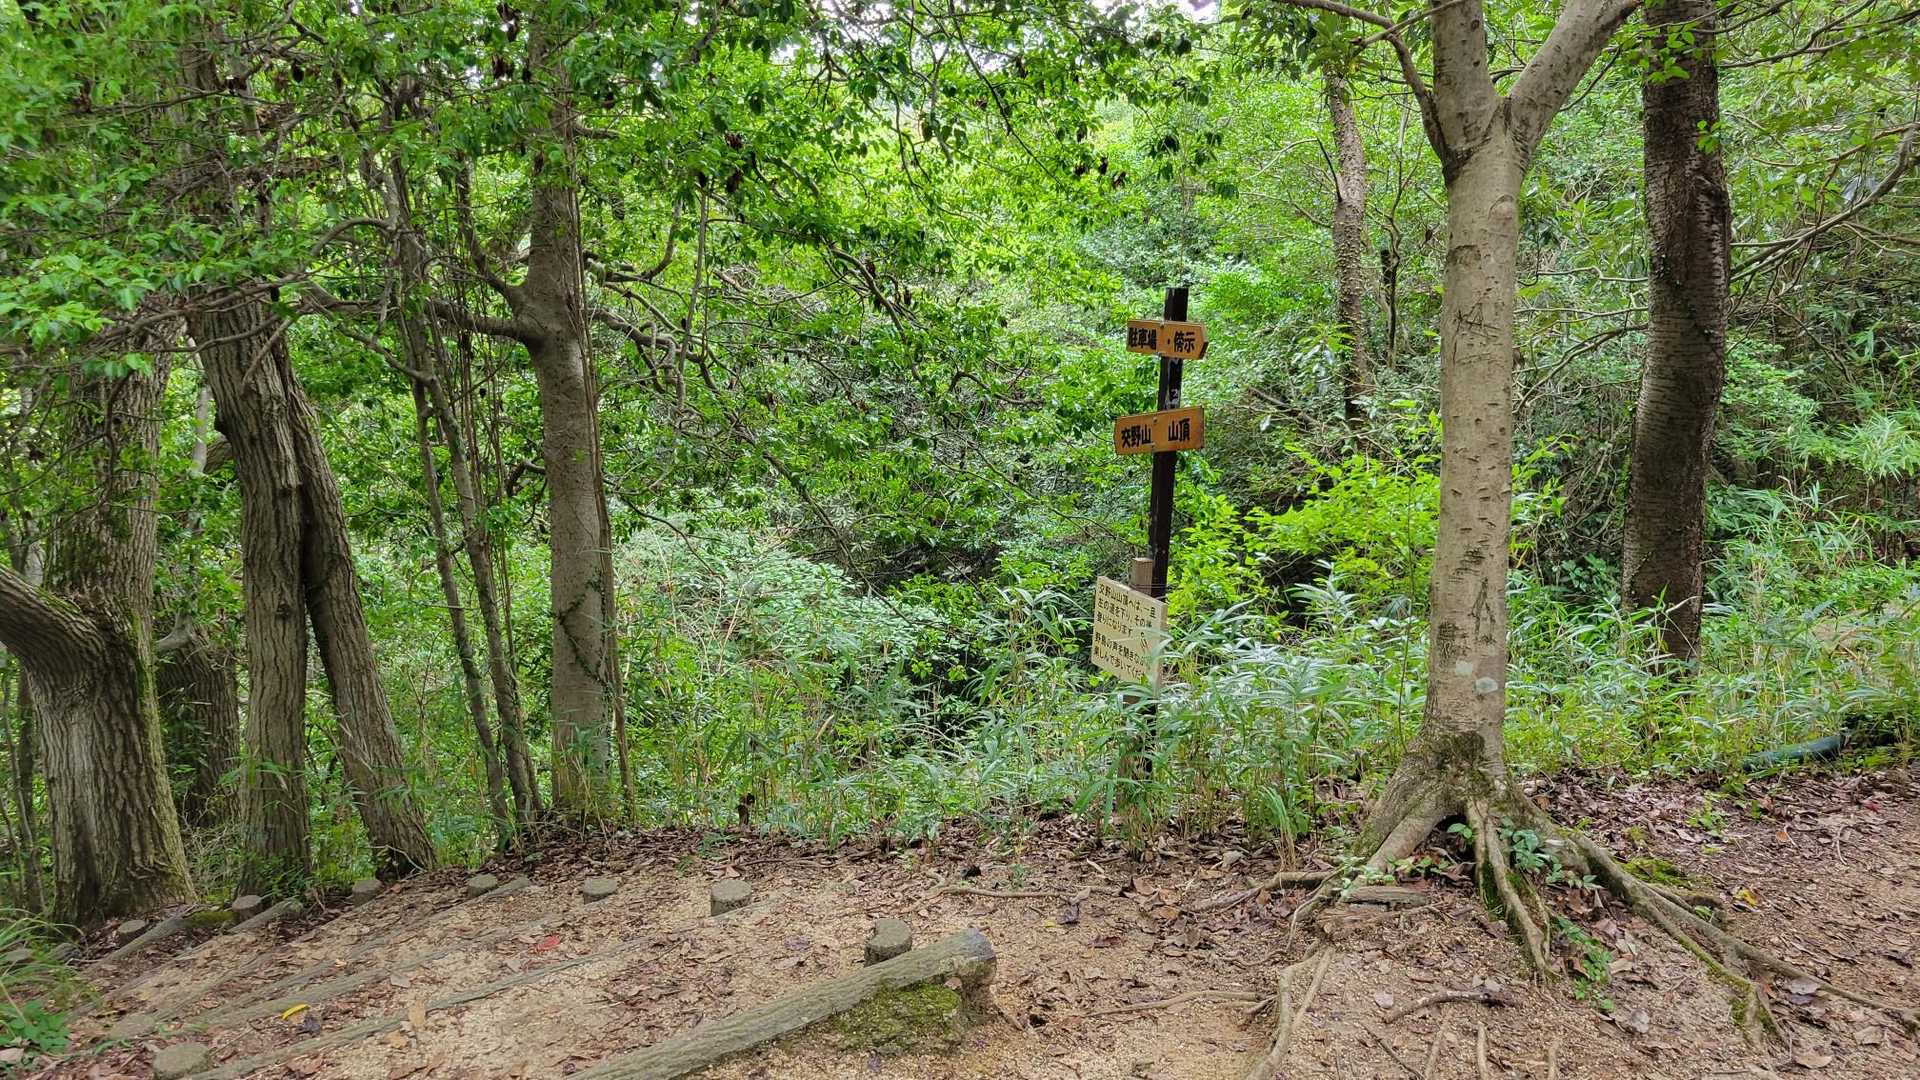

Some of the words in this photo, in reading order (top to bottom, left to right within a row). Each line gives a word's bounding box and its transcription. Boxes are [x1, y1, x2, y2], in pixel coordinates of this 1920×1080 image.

[1128, 327, 1157, 350] 駐車場
[1121, 423, 1152, 449] 交野山
[1167, 417, 1191, 443] 山頂
